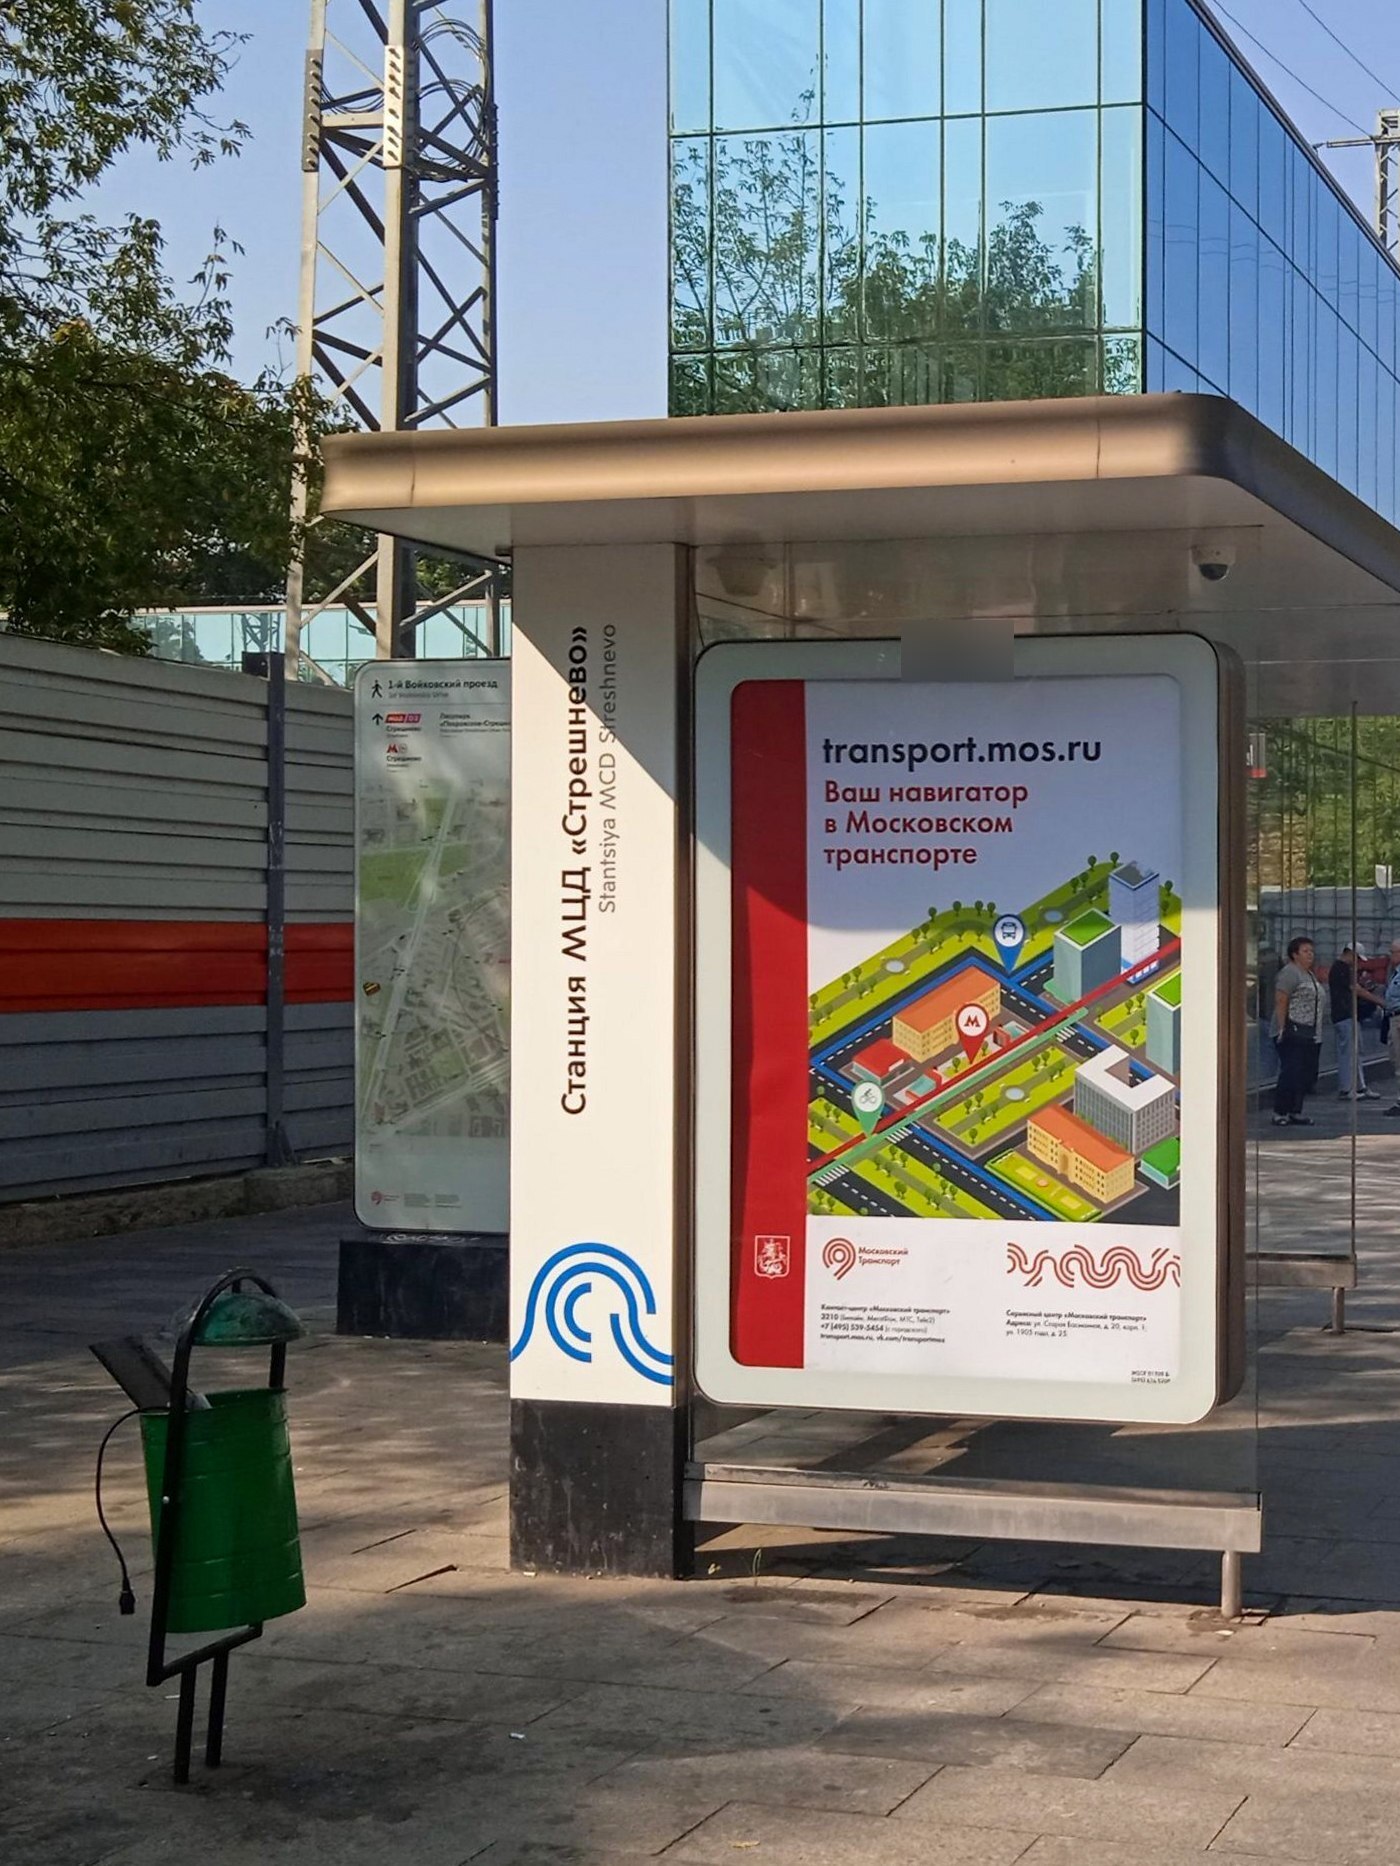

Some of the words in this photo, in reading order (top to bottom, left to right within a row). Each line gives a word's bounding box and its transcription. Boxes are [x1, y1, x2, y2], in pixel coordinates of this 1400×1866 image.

[405, 679, 461, 689] Войковский
[463, 680, 498, 690] проезд
[599, 624, 616, 744] Streshnevo
[561, 626, 592, 856] «Стрешнево»
[823, 737, 1102, 772] transport.mos.ru
[599, 752, 616, 810] MCD
[824, 780, 880, 803] Ваш
[890, 785, 1029, 809] навигатор
[824, 818, 837, 833] в
[846, 811, 1013, 834] Московском
[599, 817, 620, 913] Stantsiya
[824, 848, 978, 871] транспорте
[561, 867, 590, 962] МЦД
[561, 975, 589, 1116] Станция
[858, 1246, 909, 1255] Московский
[858, 1256, 901, 1266] Транспорт
[831, 1323, 849, 1331] (495)
